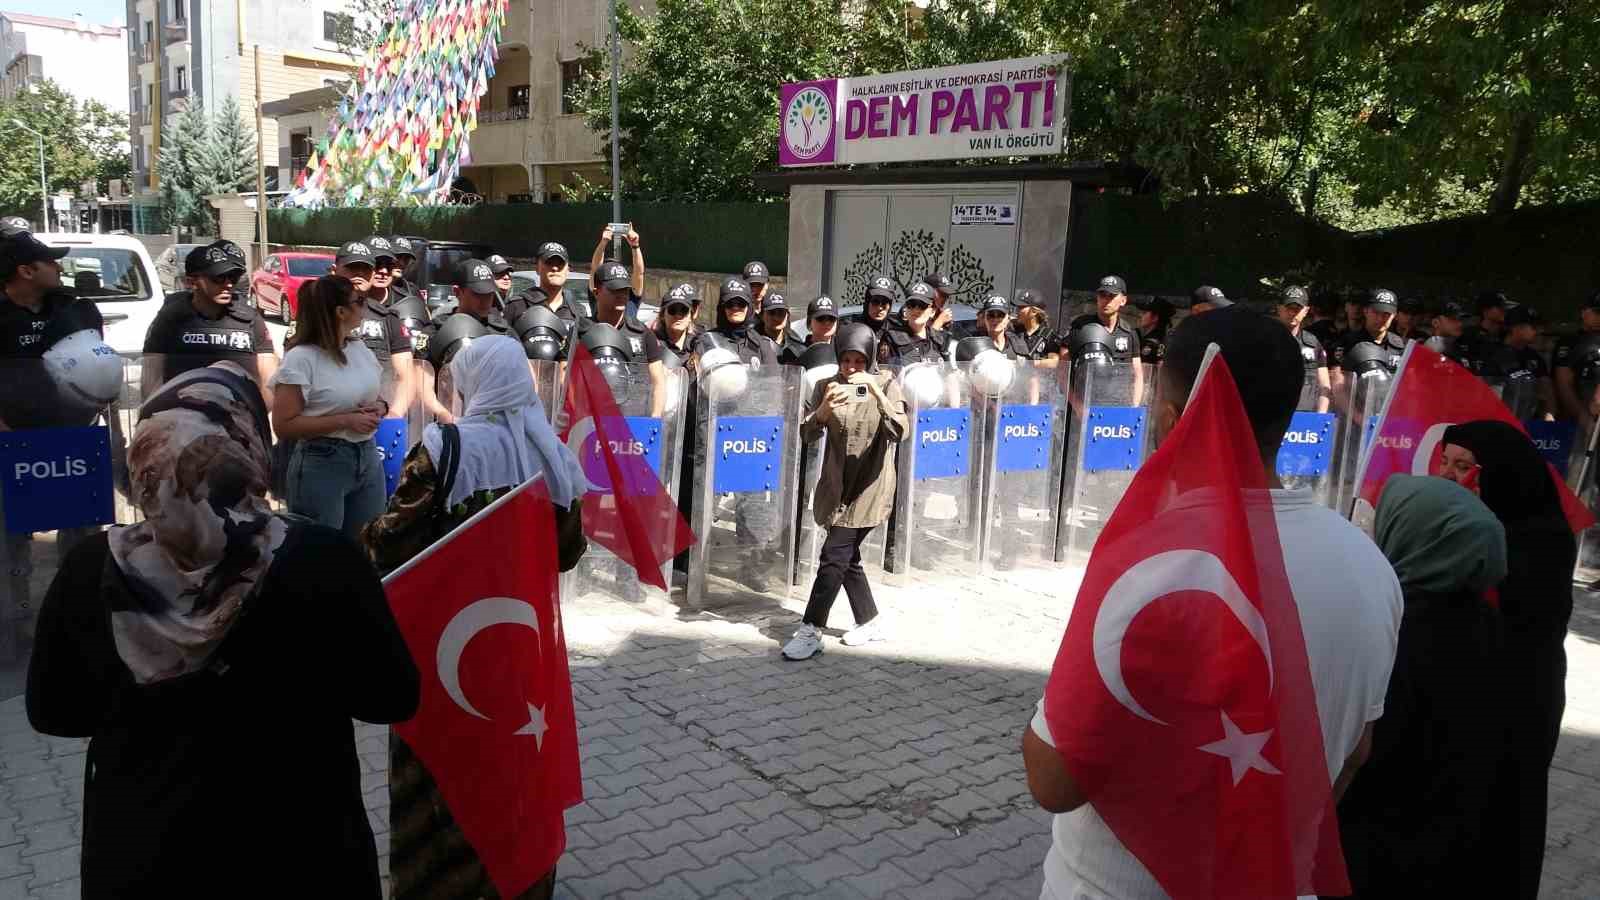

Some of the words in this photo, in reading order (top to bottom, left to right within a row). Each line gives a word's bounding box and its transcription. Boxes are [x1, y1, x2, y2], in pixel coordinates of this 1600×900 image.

[852, 85, 899, 97] HALKLARIN
[900, 77, 933, 94] EŞİTLİK
[935, 78, 947, 89] VE
[948, 71, 1003, 87] DEMOKRASİ
[845, 93, 919, 140] DEM
[929, 66, 1057, 135] PARTİ
[969, 138, 991, 150] VAN
[994, 134, 1004, 149] İL
[1006, 132, 1055, 149] ÖRGÜTÜ
[954, 205, 983, 216] 14'TE
[985, 205, 997, 216] 14
[922, 426, 957, 443] POLİS
[1004, 423, 1039, 438] POLİS
[1093, 424, 1131, 439] POLİS
[723, 437, 767, 454] POLİS
[15, 455, 88, 480] POLİS
